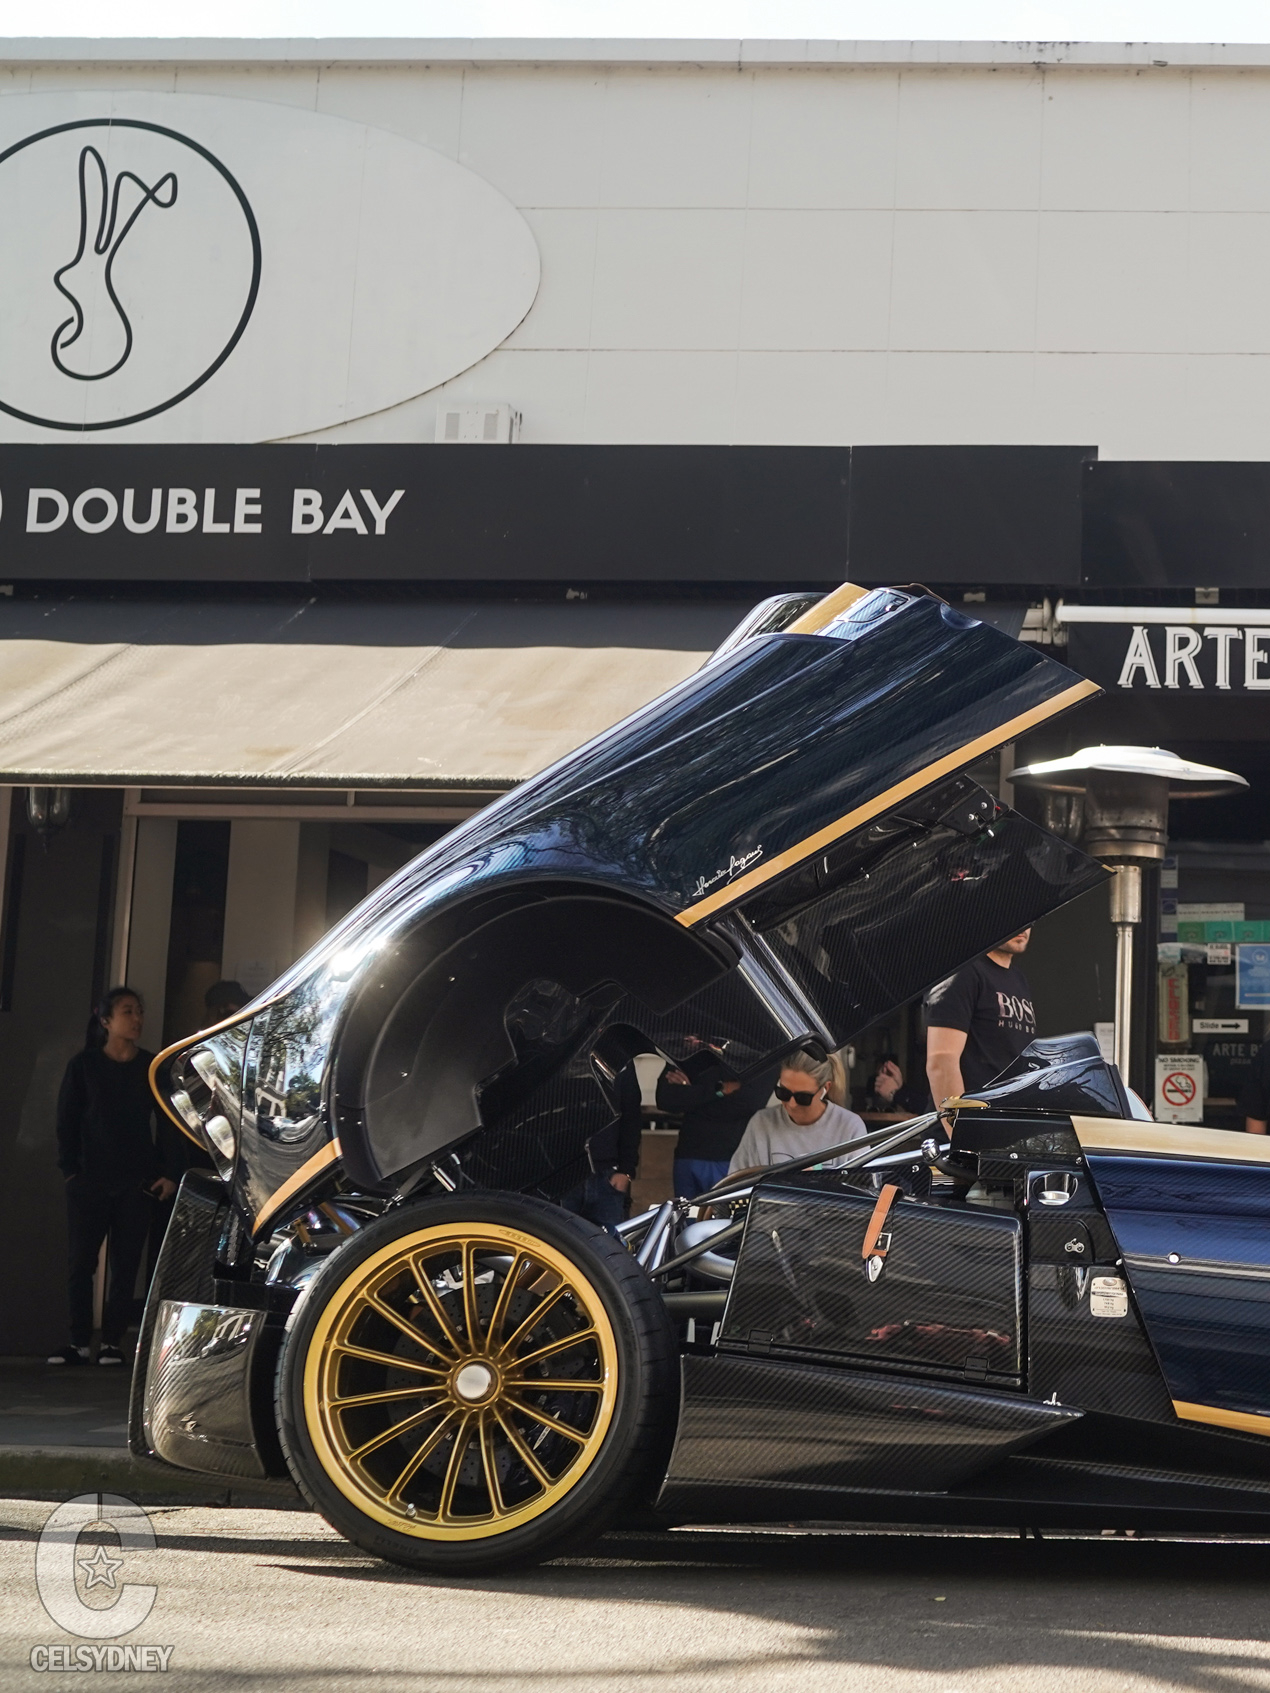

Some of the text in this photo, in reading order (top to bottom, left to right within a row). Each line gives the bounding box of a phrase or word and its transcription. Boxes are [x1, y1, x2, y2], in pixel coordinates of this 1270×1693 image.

[25, 487, 262, 534] DOUBLE
[290, 488, 405, 535] BAY
[1200, 1021, 1219, 1029] Slide
[1212, 1042, 1245, 1057] ARTE
